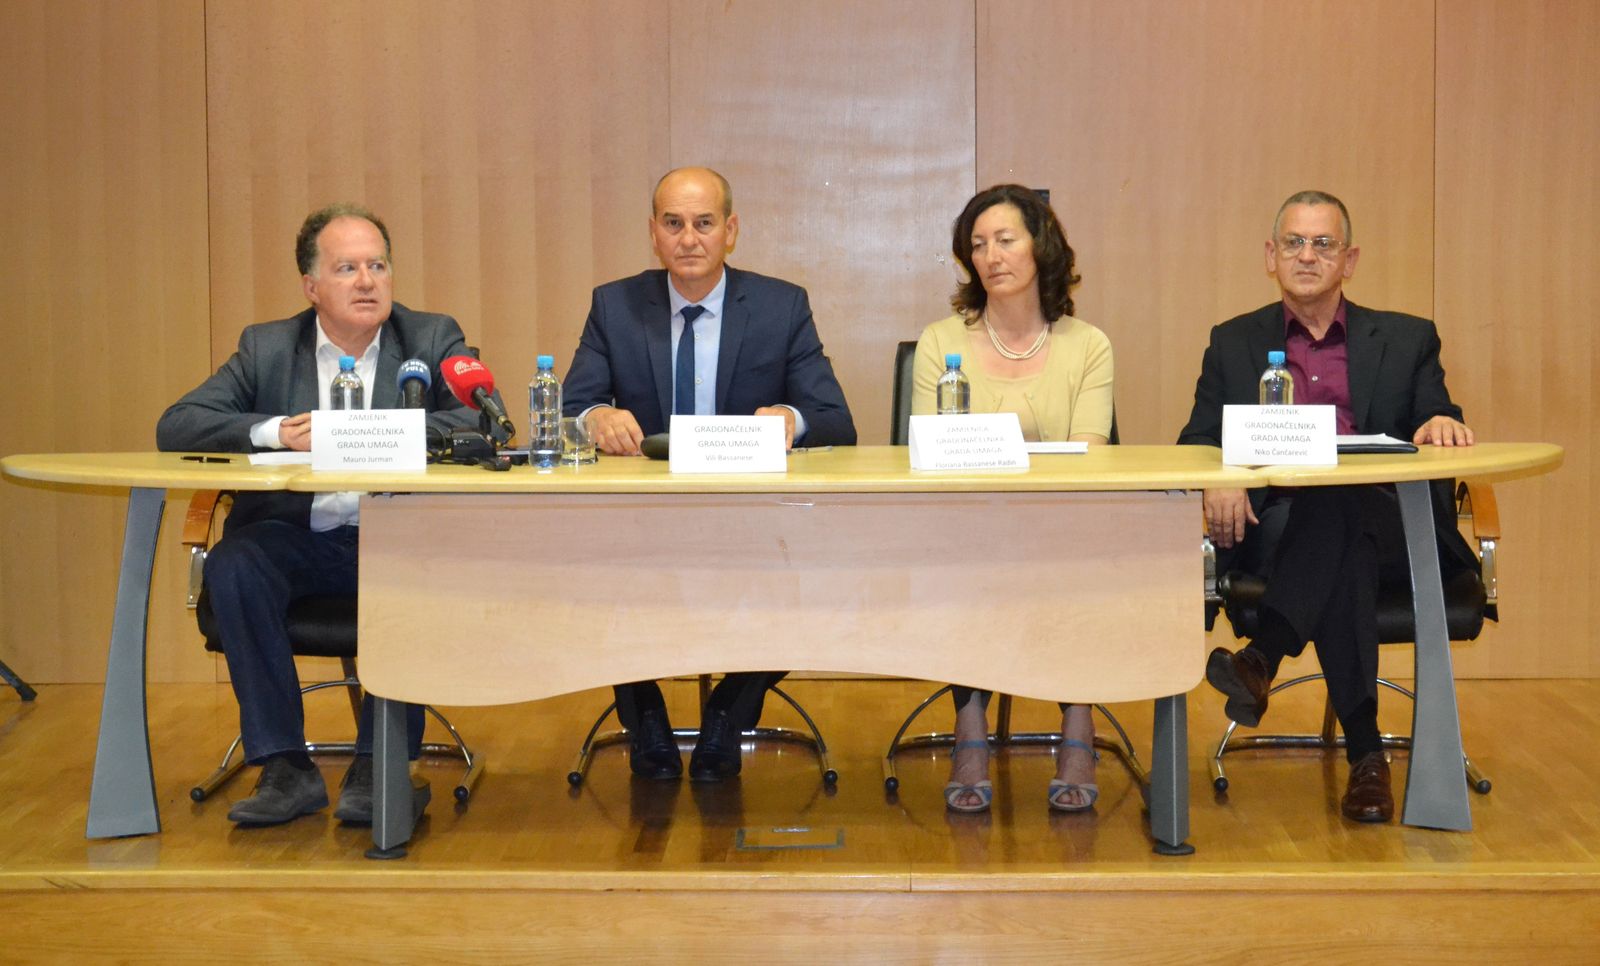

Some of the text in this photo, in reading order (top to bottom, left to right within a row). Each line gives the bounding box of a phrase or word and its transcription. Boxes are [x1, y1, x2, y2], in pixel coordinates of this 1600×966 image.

[1260, 408, 1300, 416] ZAMJENIK
[348, 414, 388, 422] ZAMJENIK
[694, 425, 763, 433] GRADONAČELNIK
[1244, 421, 1317, 430] GRADONAČELNIKA
[330, 427, 405, 437] GRADONAČELNIKA
[1250, 434, 1312, 443] GRADA UMAGA
[336, 441, 399, 450] GRADA UMAGA
[697, 440, 760, 448] GRADA UMAGA
[1254, 448, 1271, 456] Niko
[342, 455, 394, 464] Mauro Jurman
